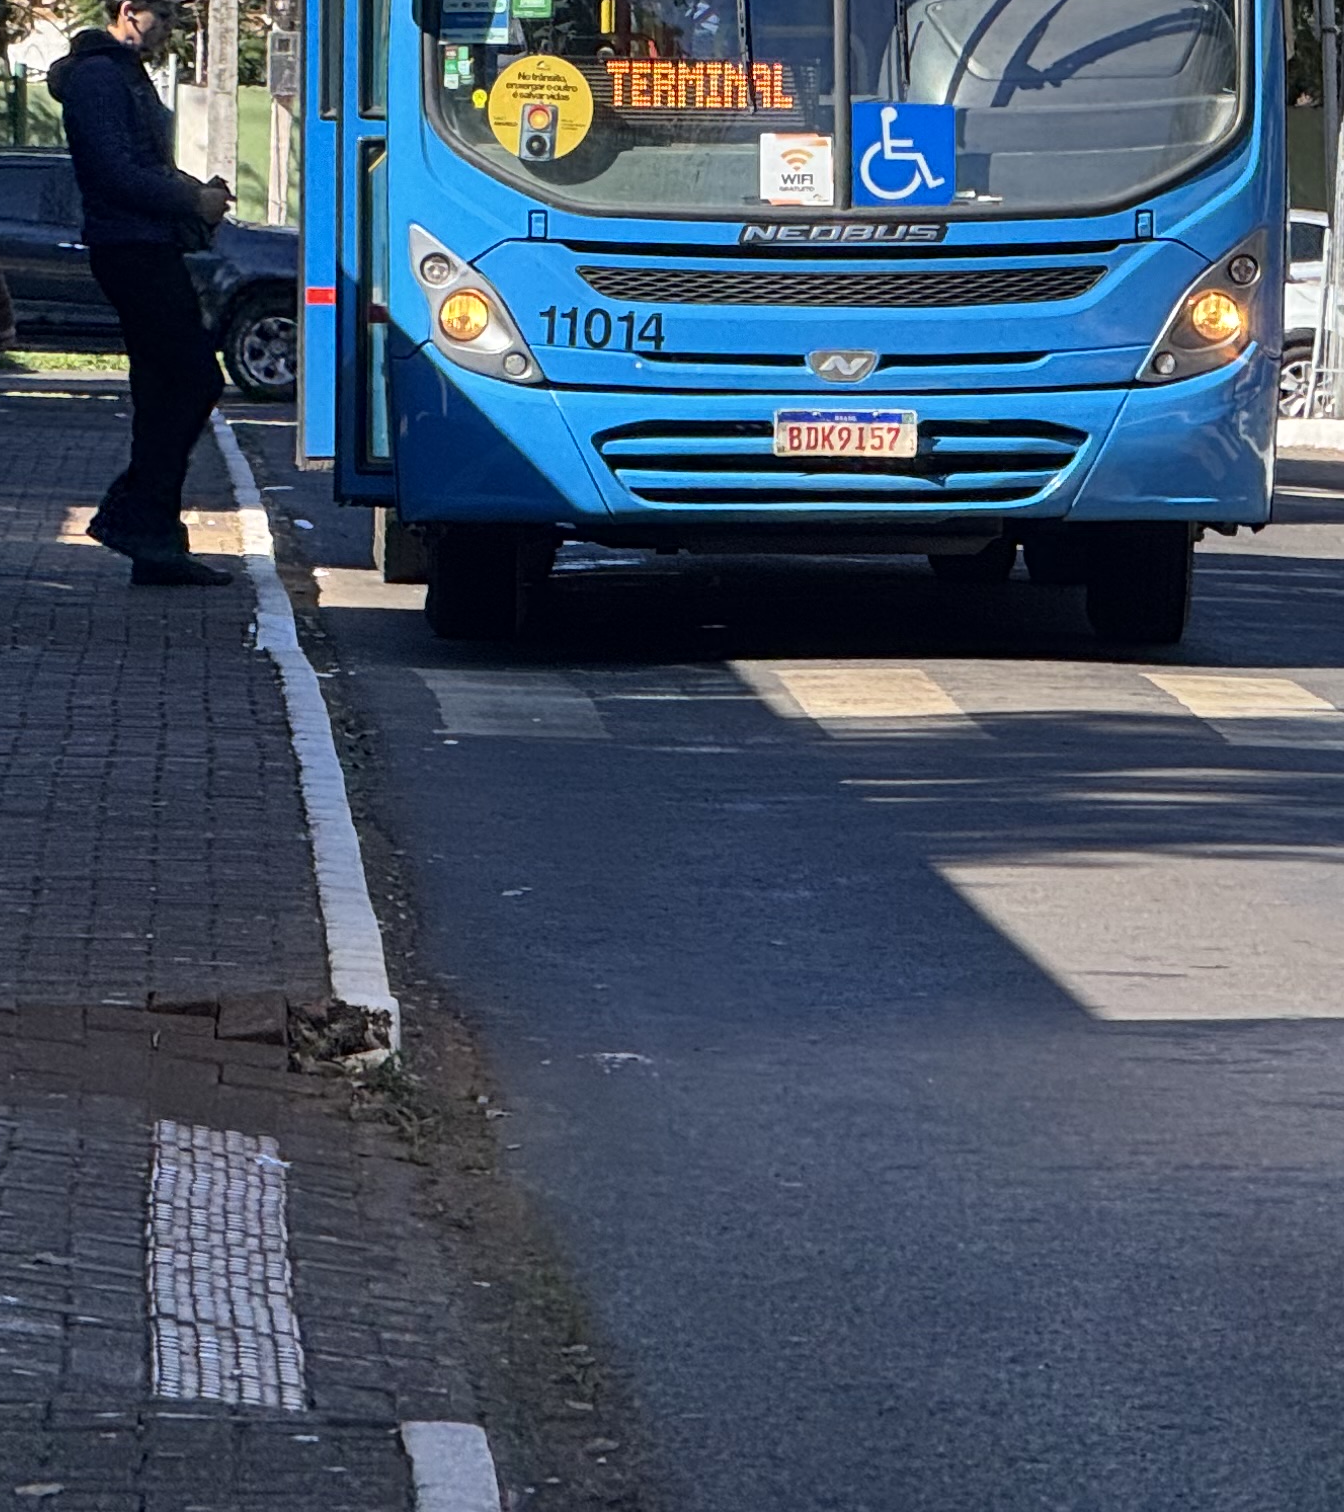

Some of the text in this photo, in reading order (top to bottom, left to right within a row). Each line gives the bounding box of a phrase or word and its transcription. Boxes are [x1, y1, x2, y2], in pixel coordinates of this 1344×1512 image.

[606, 60, 794, 109] TERMINAL
[781, 174, 814, 185] WIFI
[743, 224, 942, 241] NEOBUS
[539, 305, 666, 351] 11014
